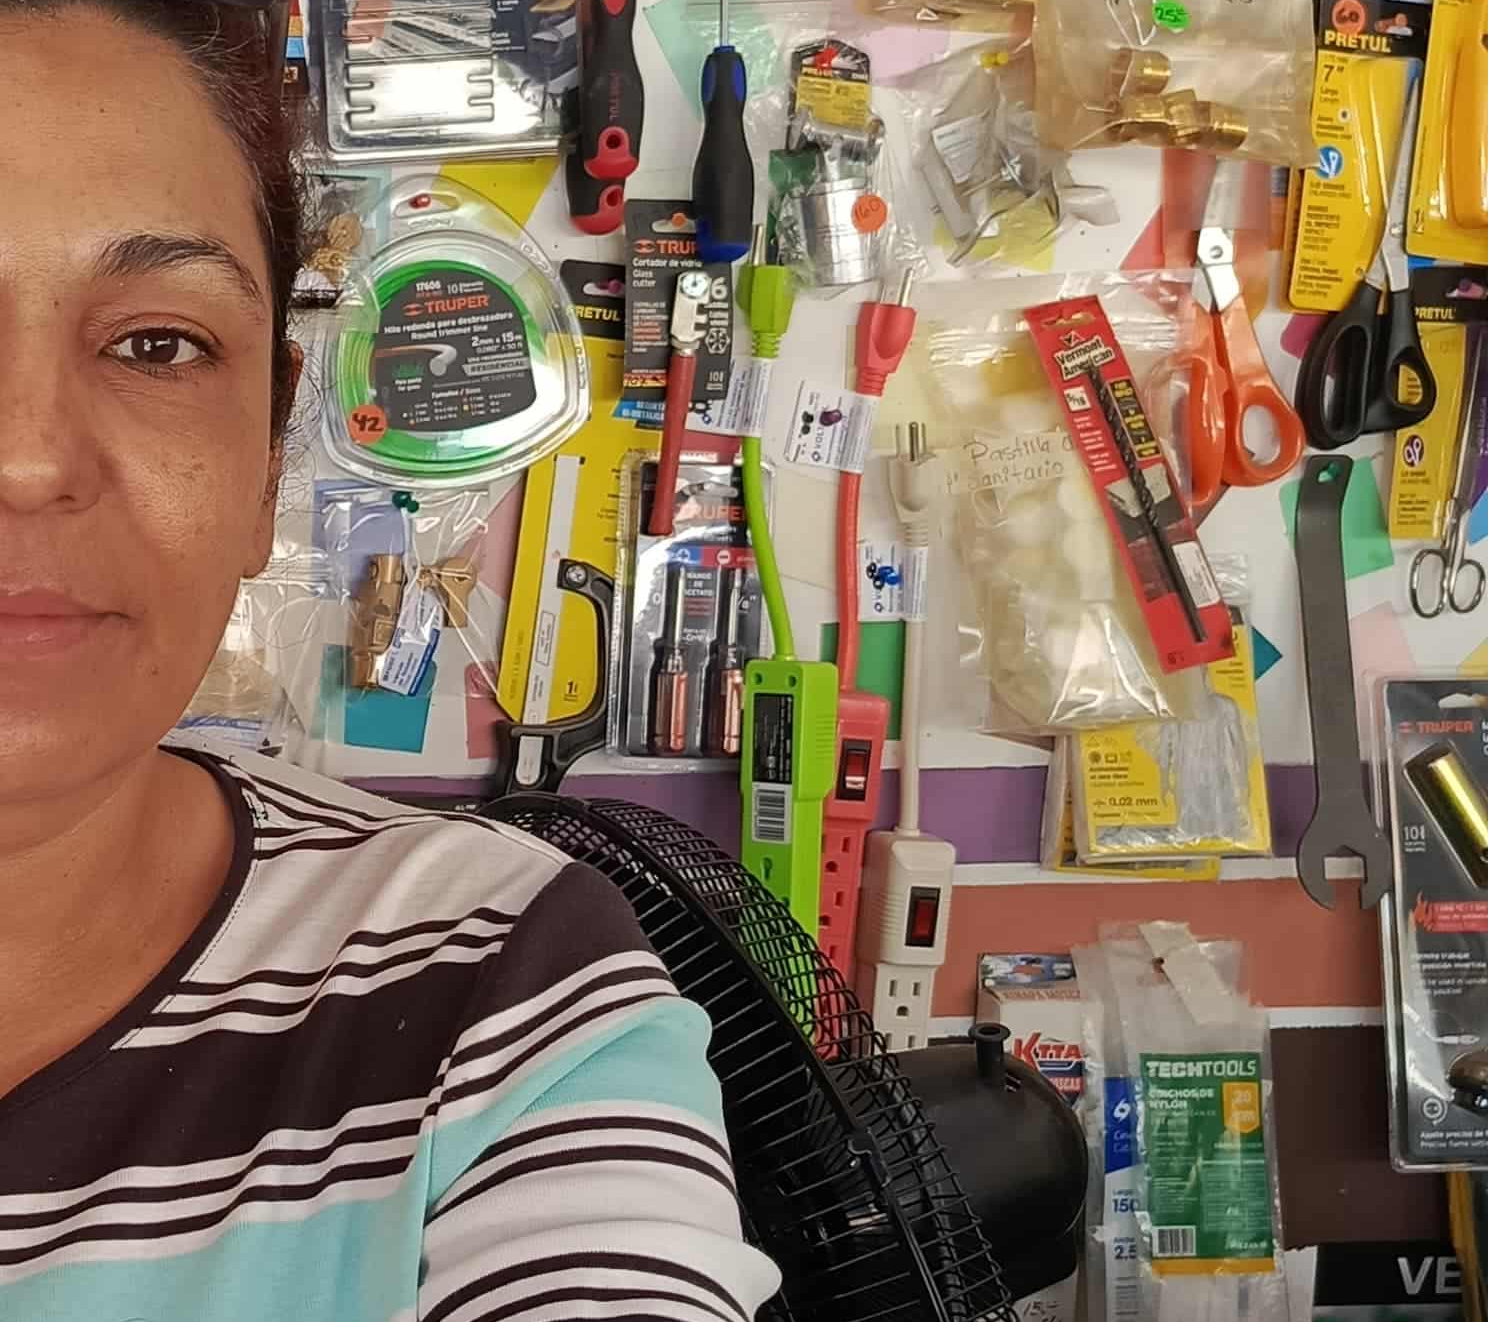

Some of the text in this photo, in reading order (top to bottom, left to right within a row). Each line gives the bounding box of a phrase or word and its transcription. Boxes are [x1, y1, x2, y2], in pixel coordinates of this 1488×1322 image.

[1324, 29, 1392, 54] PRETUL
[632, 258, 667, 268] Cortador
[632, 270, 654, 279] Glass
[632, 279, 656, 288] cutter
[424, 295, 489, 314] TRUPER
[1056, 338, 1103, 365] Vermont
[351, 412, 384, 435] 42
[1417, 720, 1474, 734] TRUPER
[1146, 1060, 1257, 1078] TECHTOOLS
